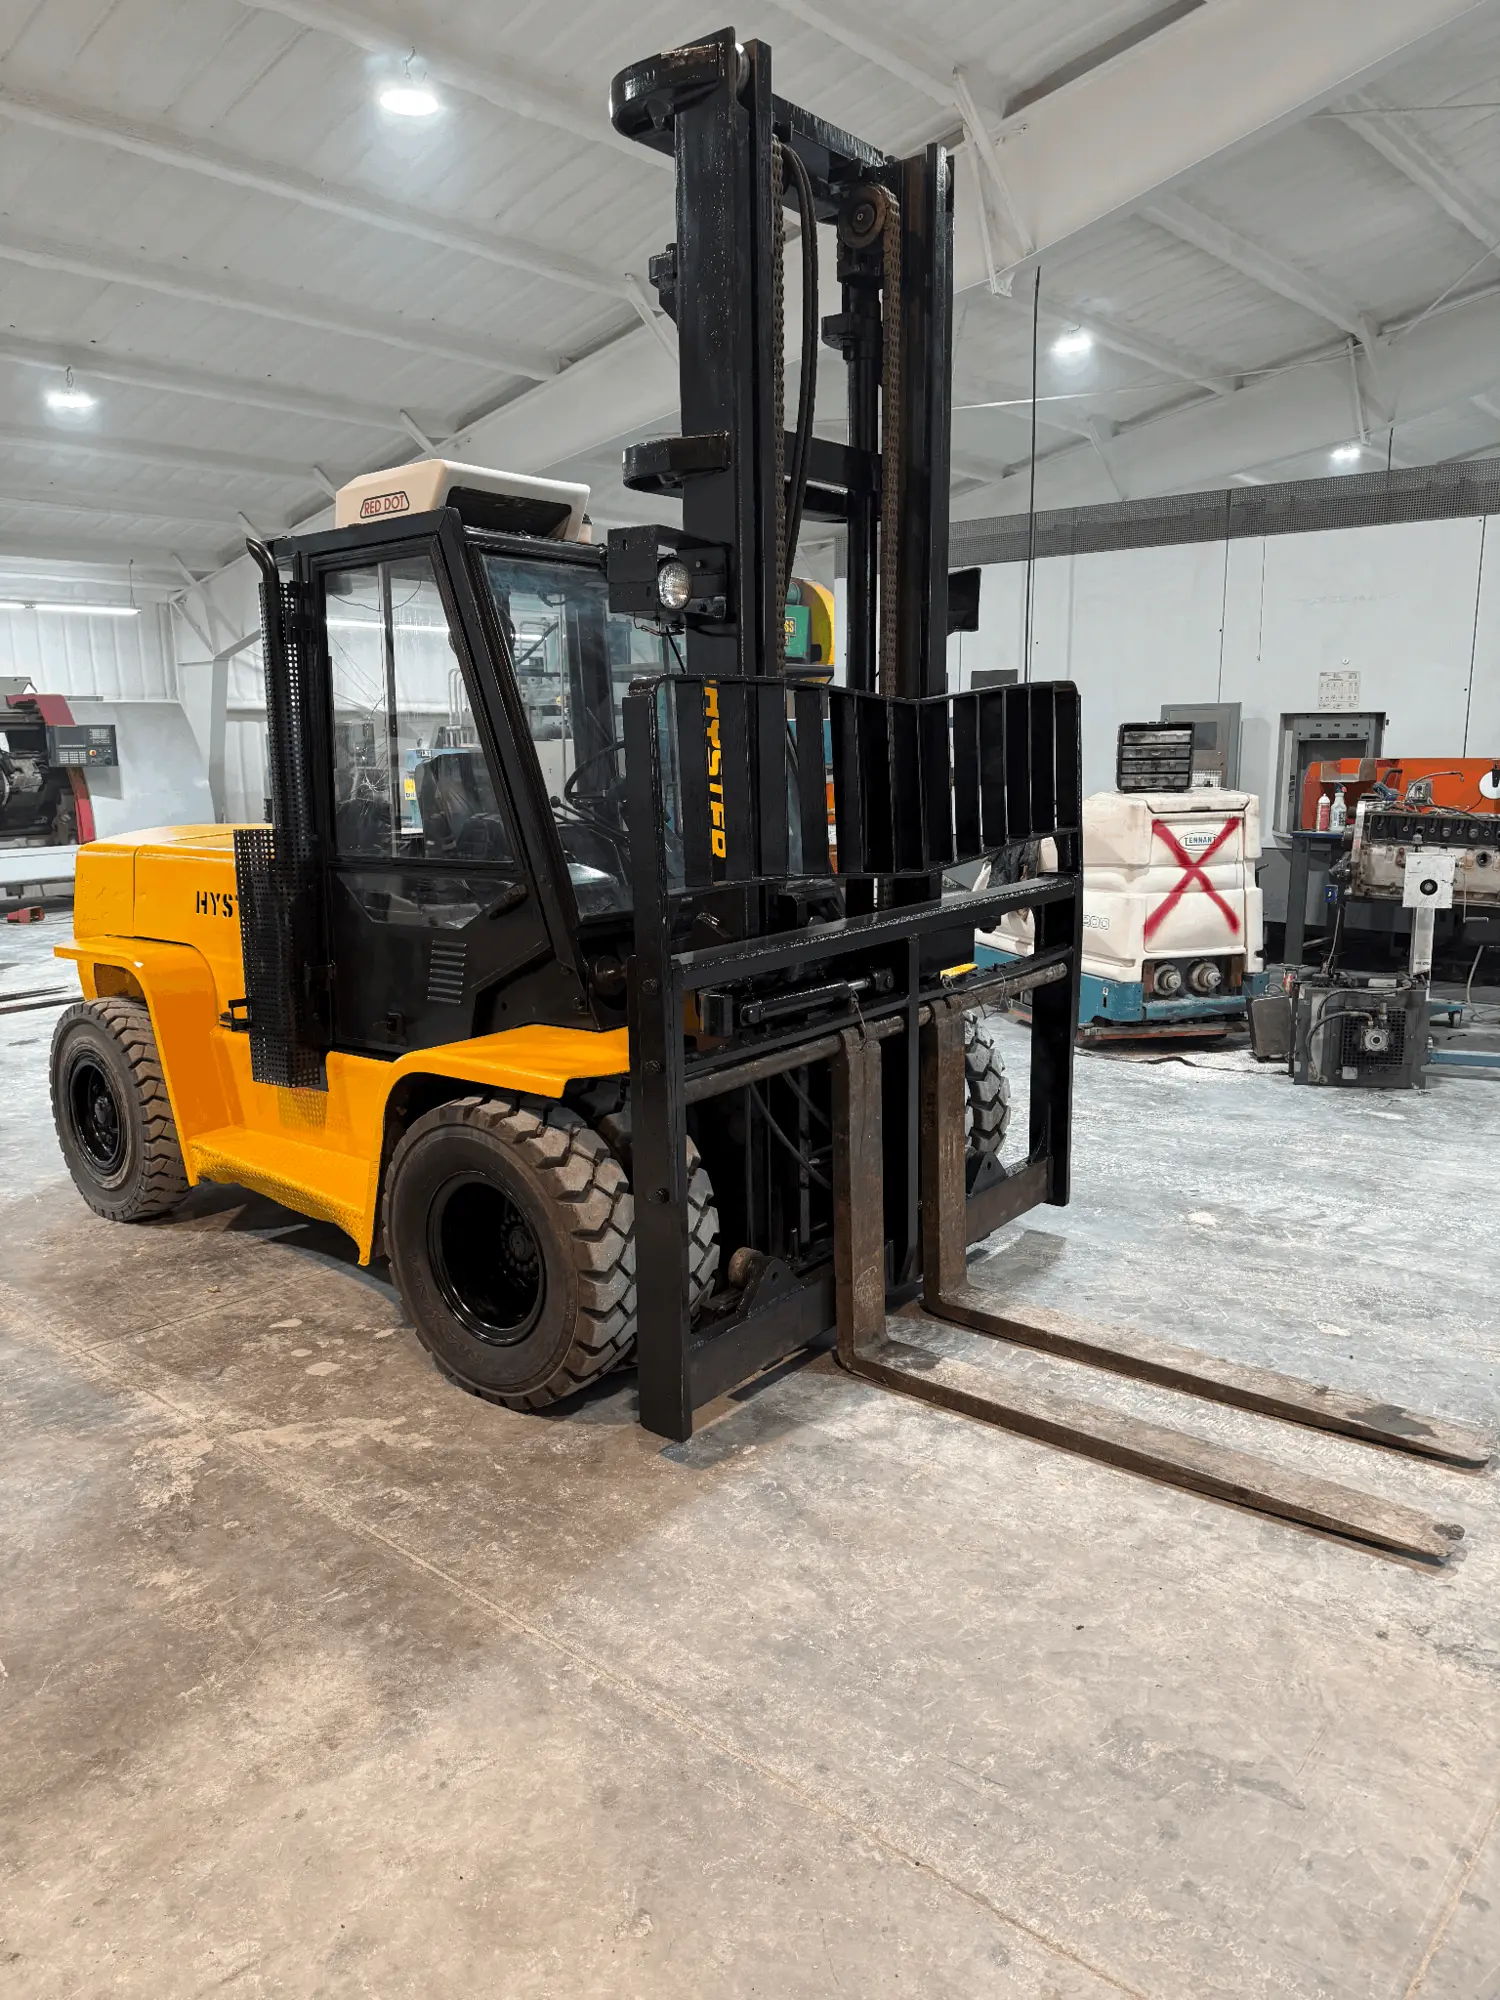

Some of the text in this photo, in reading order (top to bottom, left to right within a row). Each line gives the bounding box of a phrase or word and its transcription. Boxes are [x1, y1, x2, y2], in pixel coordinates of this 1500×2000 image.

[364, 495, 404, 515] RED DOT
[1184, 836, 1216, 846] TENNANT
[196, 891, 238, 918] HYS
